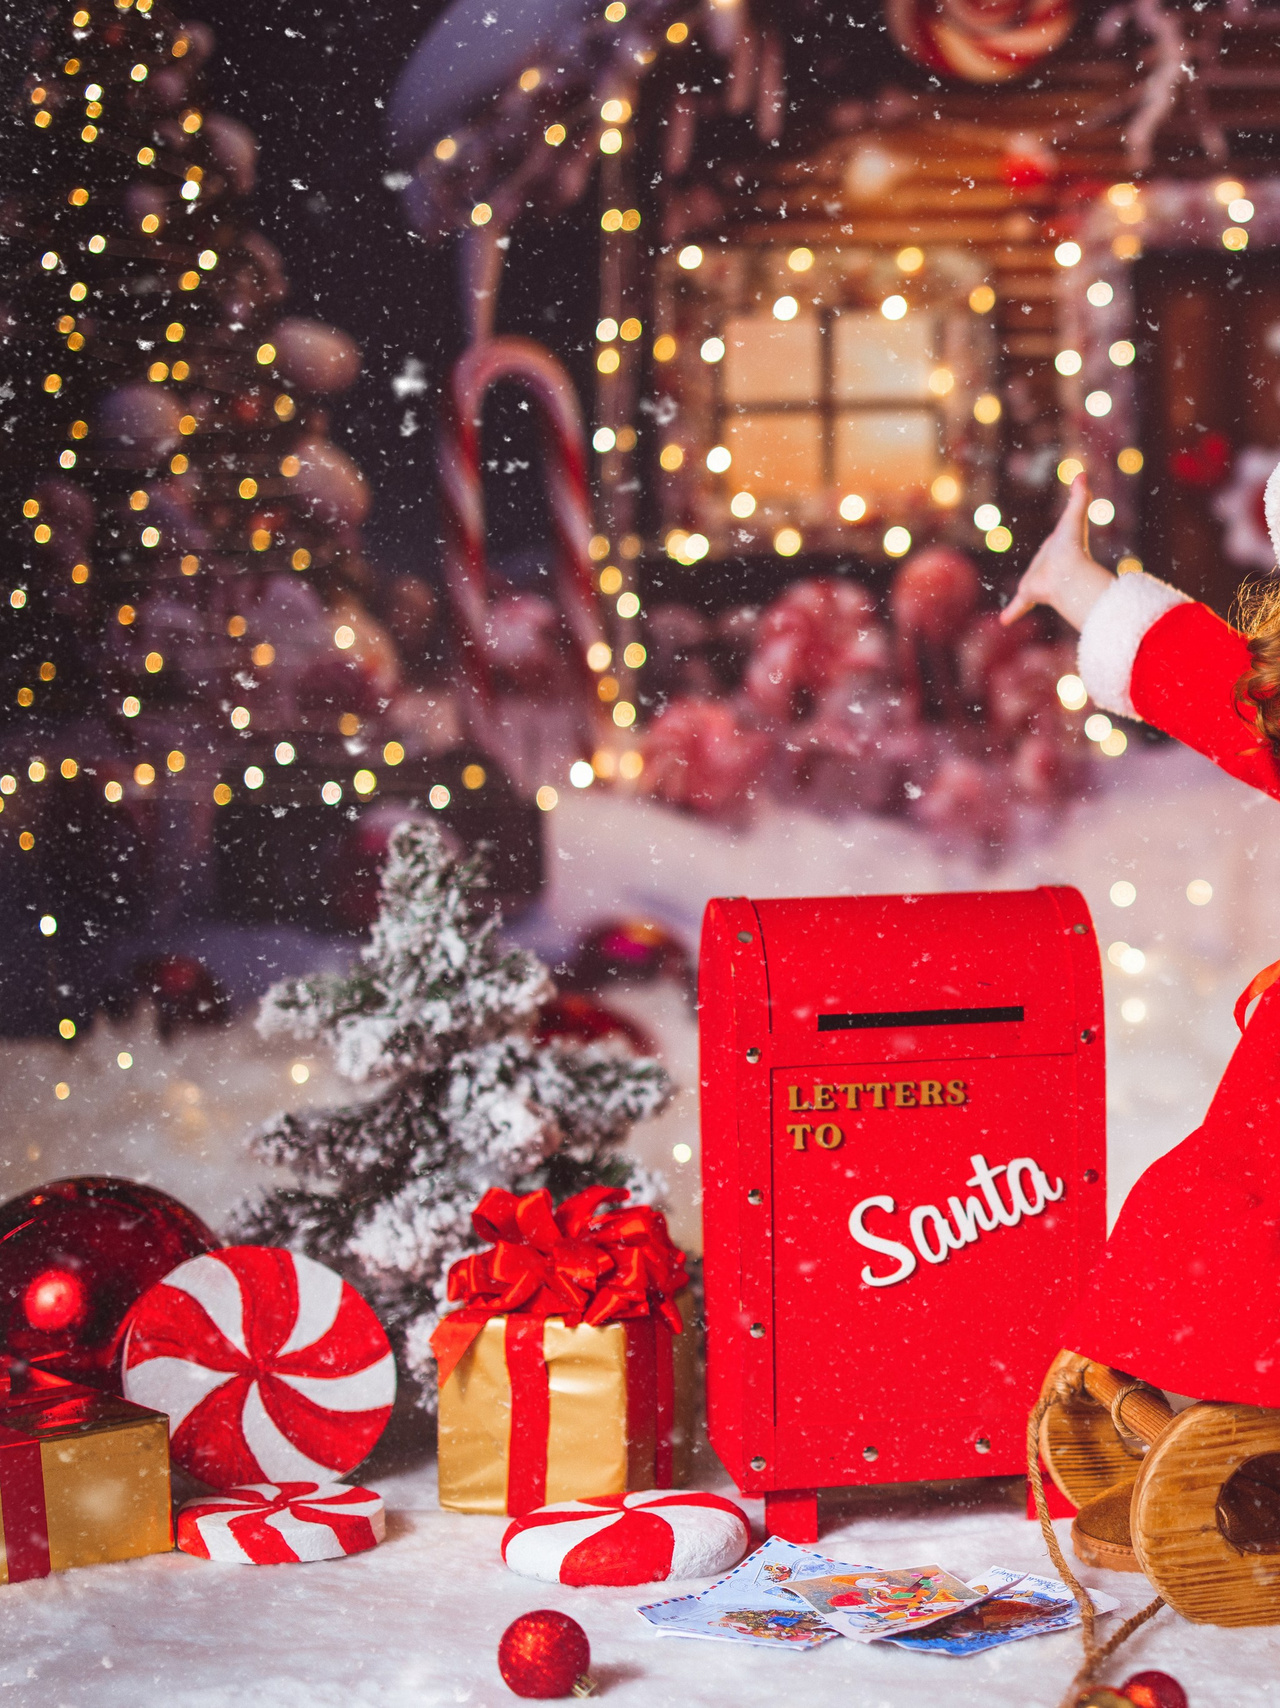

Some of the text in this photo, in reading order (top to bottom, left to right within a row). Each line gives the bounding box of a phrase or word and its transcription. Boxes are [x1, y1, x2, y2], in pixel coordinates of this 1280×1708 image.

[788, 1080, 967, 1111] LETTERS
[787, 1123, 842, 1149] TO
[848, 1154, 1064, 1287] Santa
